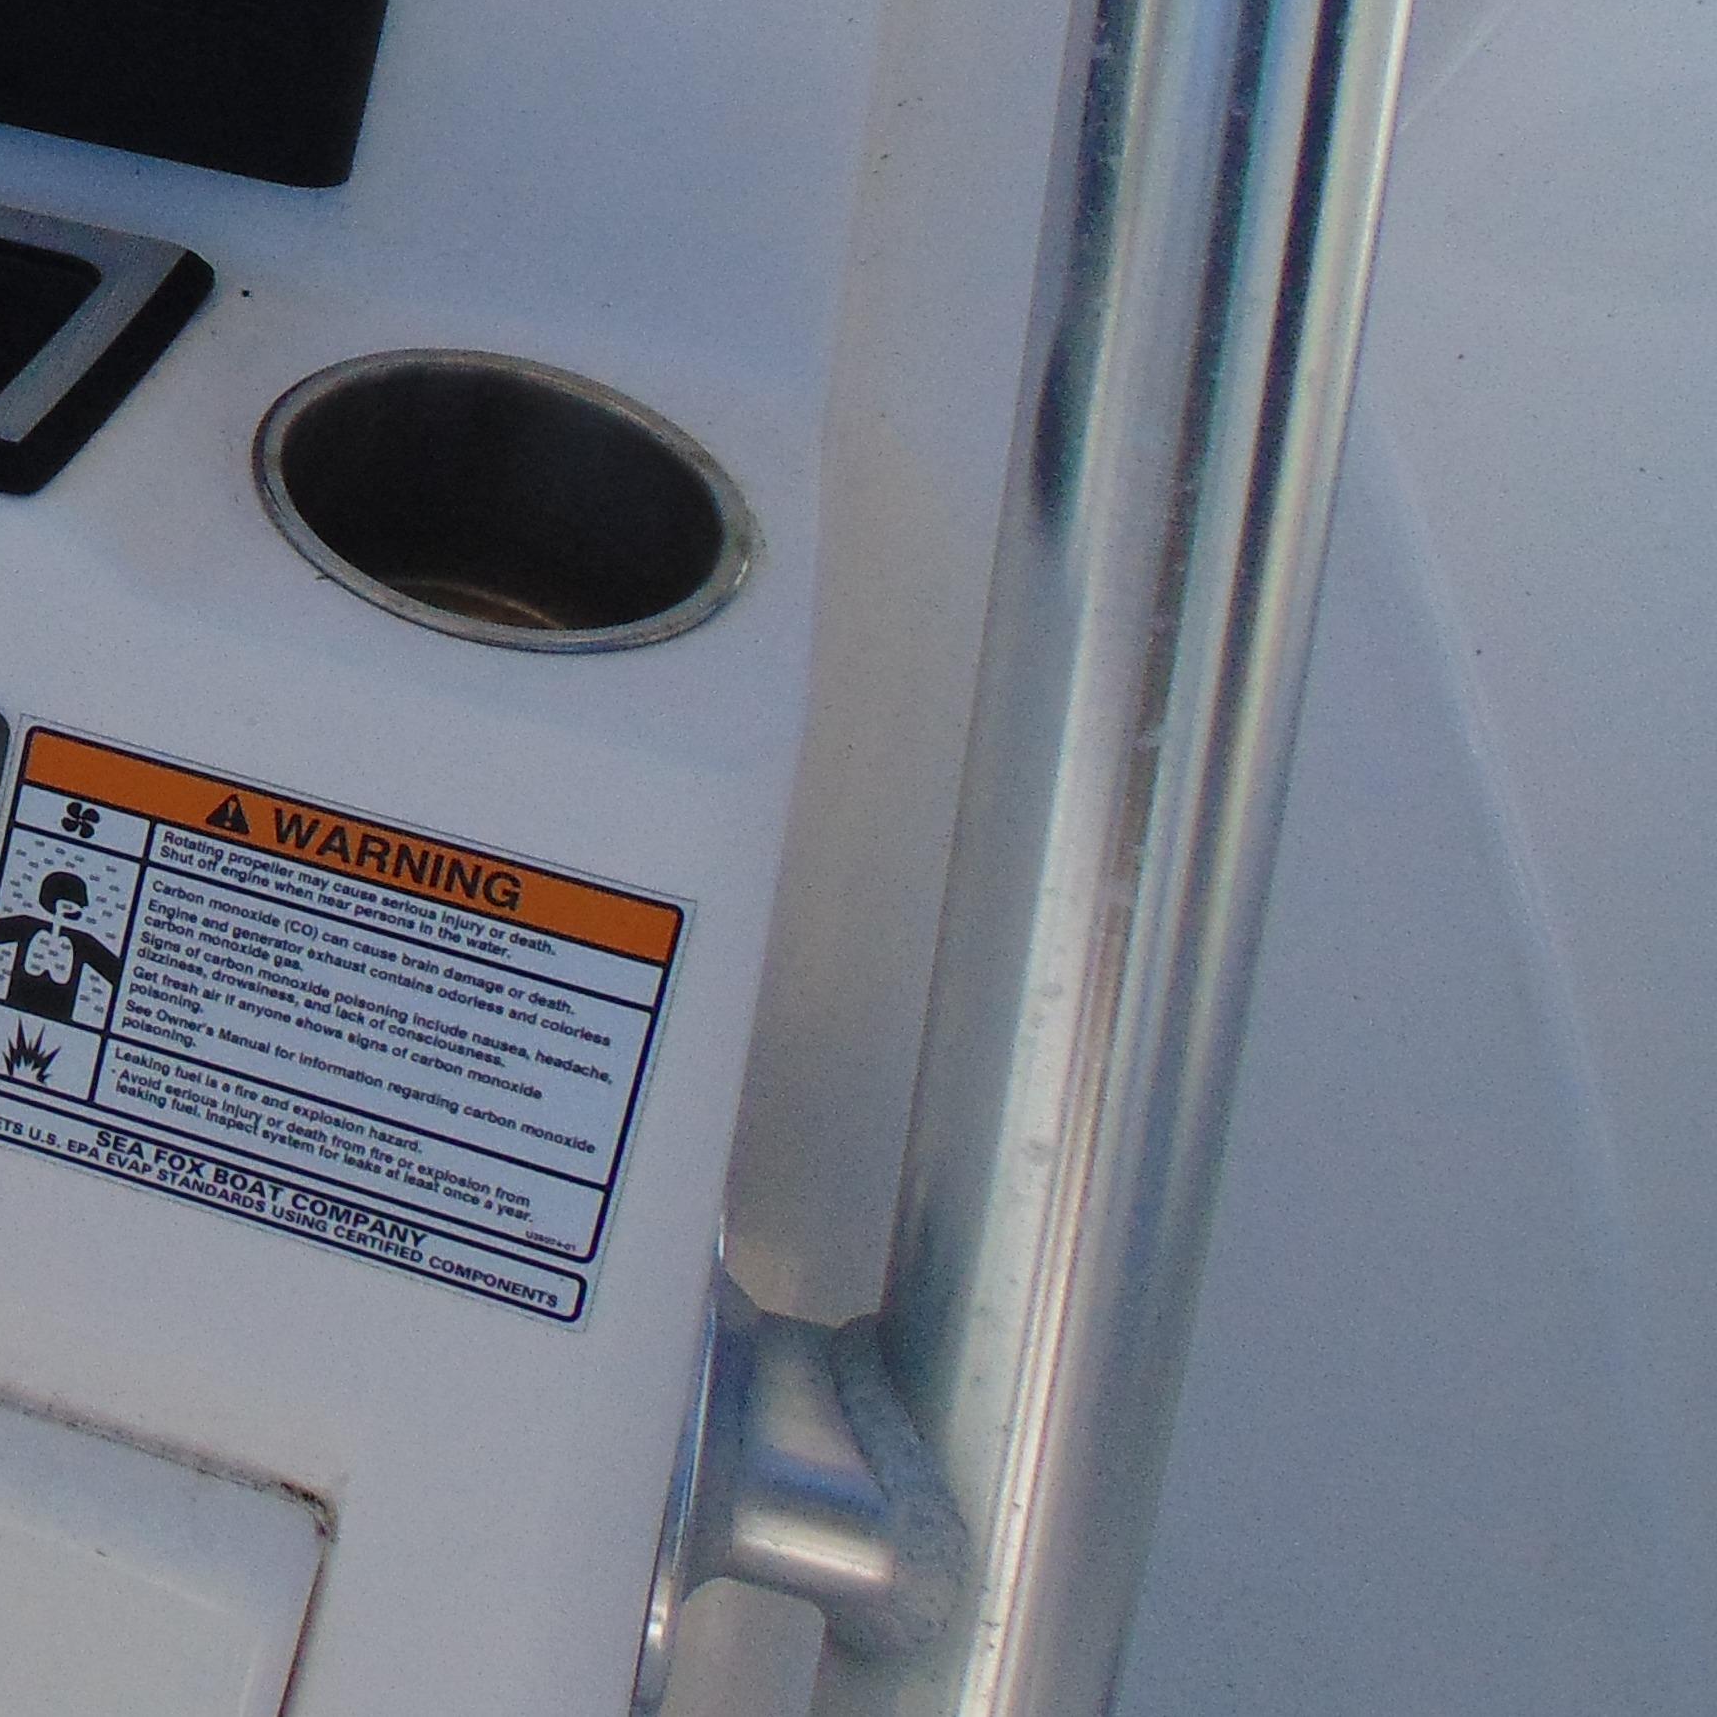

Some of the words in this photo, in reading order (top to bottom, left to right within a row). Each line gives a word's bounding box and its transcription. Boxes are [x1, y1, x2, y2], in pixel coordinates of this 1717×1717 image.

[159, 844, 194, 866] Shut
[196, 857, 219, 872] off
[219, 864, 270, 888] engine
[273, 880, 314, 901] when
[316, 892, 353, 911] near
[352, 903, 416, 930] persons
[418, 919, 433, 936] in
[436, 925, 462, 944] the
[465, 936, 511, 959] water.
[162, 829, 225, 862] Rotating
[226, 851, 295, 879] propeller
[296, 870, 330, 892] may
[331, 881, 378, 903] cause
[379, 895, 437, 921] serious
[440, 910, 486, 937] injury
[487, 926, 506, 940] or
[508, 931, 556, 956] death.
[273, 806, 522, 911] WARNING
[127, 981, 204, 1015] poisoning.
[143, 914, 195, 939] carbon
[197, 930, 271, 961] monoxide
[146, 897, 198, 924] Engine
[200, 916, 229, 933] and
[231, 925, 304, 955] generator
[306, 947, 367, 974] exhaust
[368, 967, 434, 995] contains
[436, 986, 505, 1015] odorless
[507, 1007, 538, 1025] and
[539, 1017, 611, 1047] colorless
[151, 878, 205, 905] Carbon
[207, 897, 281, 928] monoxide
[283, 918, 319, 941] (CO)
[320, 931, 349, 949] can
[351, 940, 398, 963] cause
[400, 952, 440, 975] brain
[442, 966, 505, 995] damage
[506, 986, 526, 1000] or
[527, 991, 575, 1015] death.
[120, 1015, 196, 1049] poisoning.
[132, 964, 159, 984] Get
[161, 973, 199, 996] fresh
[201, 987, 222, 1002] air
[223, 992, 236, 1006] if
[236, 999, 292, 1024] anyone
[294, 1016, 343, 1040] shows
[346, 1031, 388, 1053] signs
[390, 1046, 409, 1059] of
[409, 1051, 463, 1076] carbon
[466, 1068, 543, 1100] monoxide
[135, 946, 208, 979] dizziness,
[210, 968, 299, 1007] drowsiness,
[302, 997, 332, 1015] and
[334, 1004, 365, 1025] lack
[367, 1017, 386, 1031] of
[387, 1023, 505, 1068] consciousness.
[139, 929, 181, 954] Signs
[184, 945, 202, 959] of
[202, 951, 254, 975] carbon
[256, 967, 330, 999] monoxide
[332, 991, 409, 1025] poisoning
[411, 1011, 468, 1040] include
[533, 1048, 612, 1085] headache,
[113, 1045, 171, 1077] Leaking
[173, 1064, 202, 1084] fuel
[203, 1073, 218, 1089] is
[233, 1083, 259, 1101] fire
[259, 1094, 290, 1111] and
[291, 1104, 365, 1135] explosion
[367, 1125, 422, 1154] hazard.
[124, 997, 153, 1018] See
[155, 1007, 215, 1037] Owner's
[217, 1026, 271, 1054] Manual
[273, 1044, 296, 1061] for
[298, 1051, 383, 1088] information
[386, 1081, 460, 1115] regarding
[462, 1105, 517, 1130] carbon
[519, 1122, 596, 1154] monoxide
[94, 1129, 145, 1160] SEA
[152, 1146, 206, 1179] FOX
[211, 1165, 285, 1202] BOAT
[290, 1191, 428, 1248] COMPANY
[118, 1067, 162, 1091] Avoid
[163, 1083, 218, 1109] serious
[220, 1098, 263, 1125] injury
[265, 1116, 284, 1129] or
[285, 1121, 328, 1143] death
[330, 1133, 366, 1156] from
[369, 1145, 394, 1164] fire
[396, 1156, 415, 1170] or
[416, 1163, 491, 1195] explosion
[494, 1185, 531, 1208] from
[260, 1128, 315, 1154] system
[317, 1143, 340, 1160] for
[342, 1151, 382, 1175] leaks
[384, 1167, 401, 1181] at
[402, 1170, 441, 1193] least
[441, 1185, 481, 1206] once
[495, 1202, 533, 1223] year.
[27, 1125, 61, 1148] U.S.
[66, 1137, 100, 1161] EPA
[104, 1150, 153, 1175] EVAP
[155, 1167, 266, 1213] STANDARDS
[270, 1203, 328, 1233] USING
[332, 1223, 424, 1264] CERTIFIED
[427, 1254, 558, 1308] COMPONENTS
